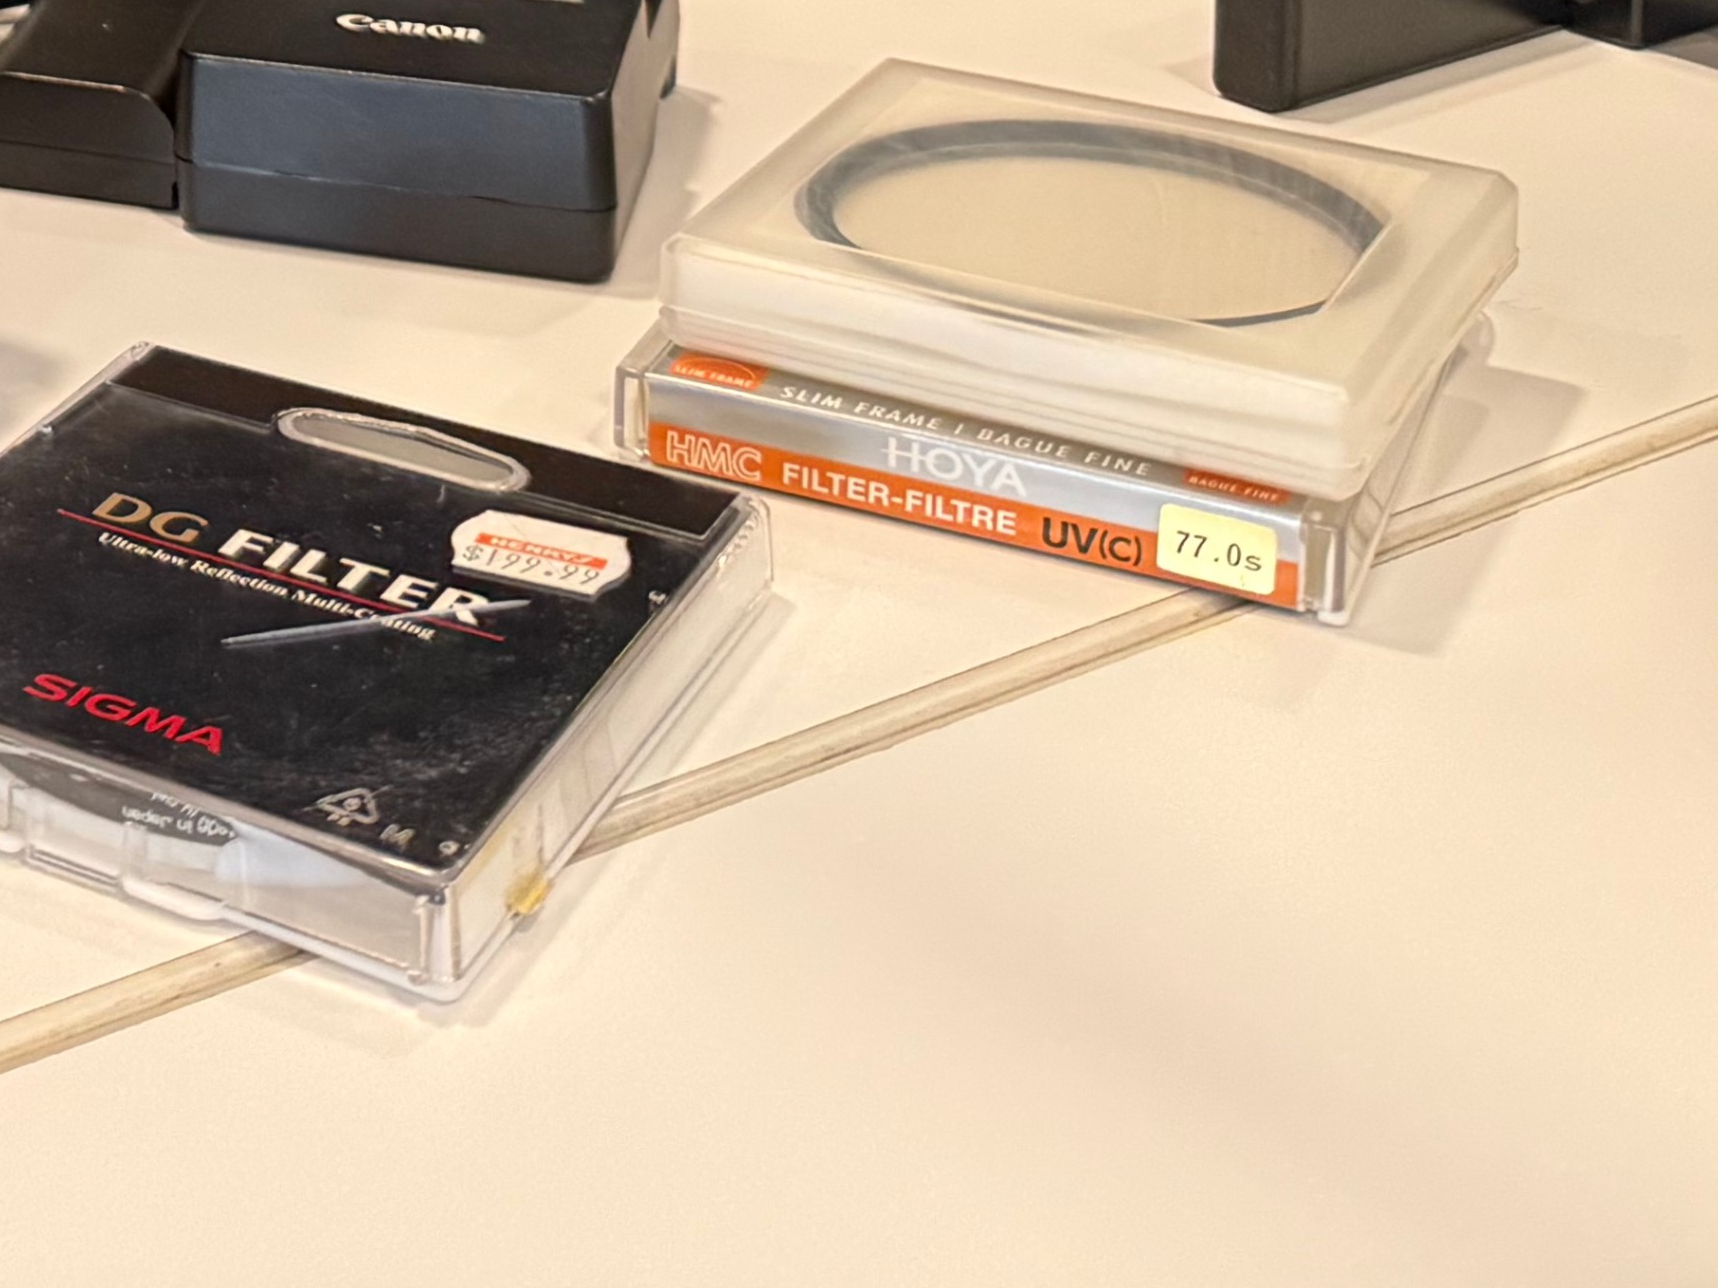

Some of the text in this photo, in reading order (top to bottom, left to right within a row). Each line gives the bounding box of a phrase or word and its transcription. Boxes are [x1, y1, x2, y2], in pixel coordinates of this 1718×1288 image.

[335, 13, 486, 44] Canon
[665, 429, 762, 482] HMC
[780, 386, 842, 409] SLIM
[854, 401, 943, 430] FRAME
[977, 428, 1072, 458] BAGUE
[1084, 451, 1153, 476] FINE
[880, 436, 1027, 497] HOYA
[1188, 475, 1237, 493] BAGUE
[782, 462, 1017, 536] FILTER-FILTRE
[92, 492, 491, 626] DG FILTER
[98, 532, 188, 568] Ultra-low
[190, 559, 289, 598] Reflection
[462, 545, 599, 585] $199.99
[1176, 530, 1263, 572] 77.0s
[22, 673, 223, 756] SIGMA
